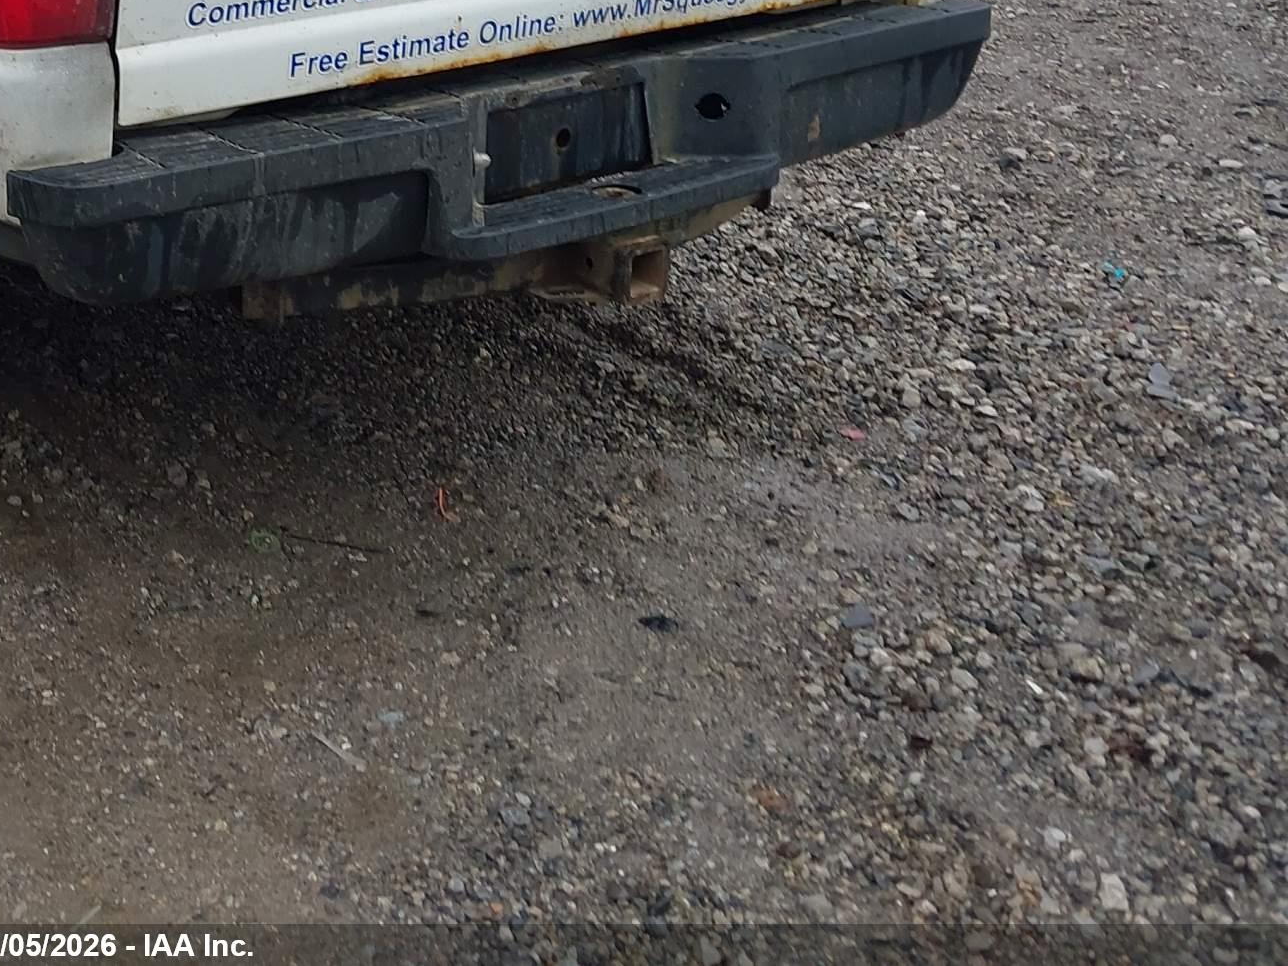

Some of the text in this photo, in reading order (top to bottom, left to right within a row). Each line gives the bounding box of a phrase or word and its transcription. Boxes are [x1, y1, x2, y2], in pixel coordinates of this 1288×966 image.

[289, 50, 348, 78] Free
[359, 30, 471, 65] Estimate
[478, 12, 563, 44] Online:
